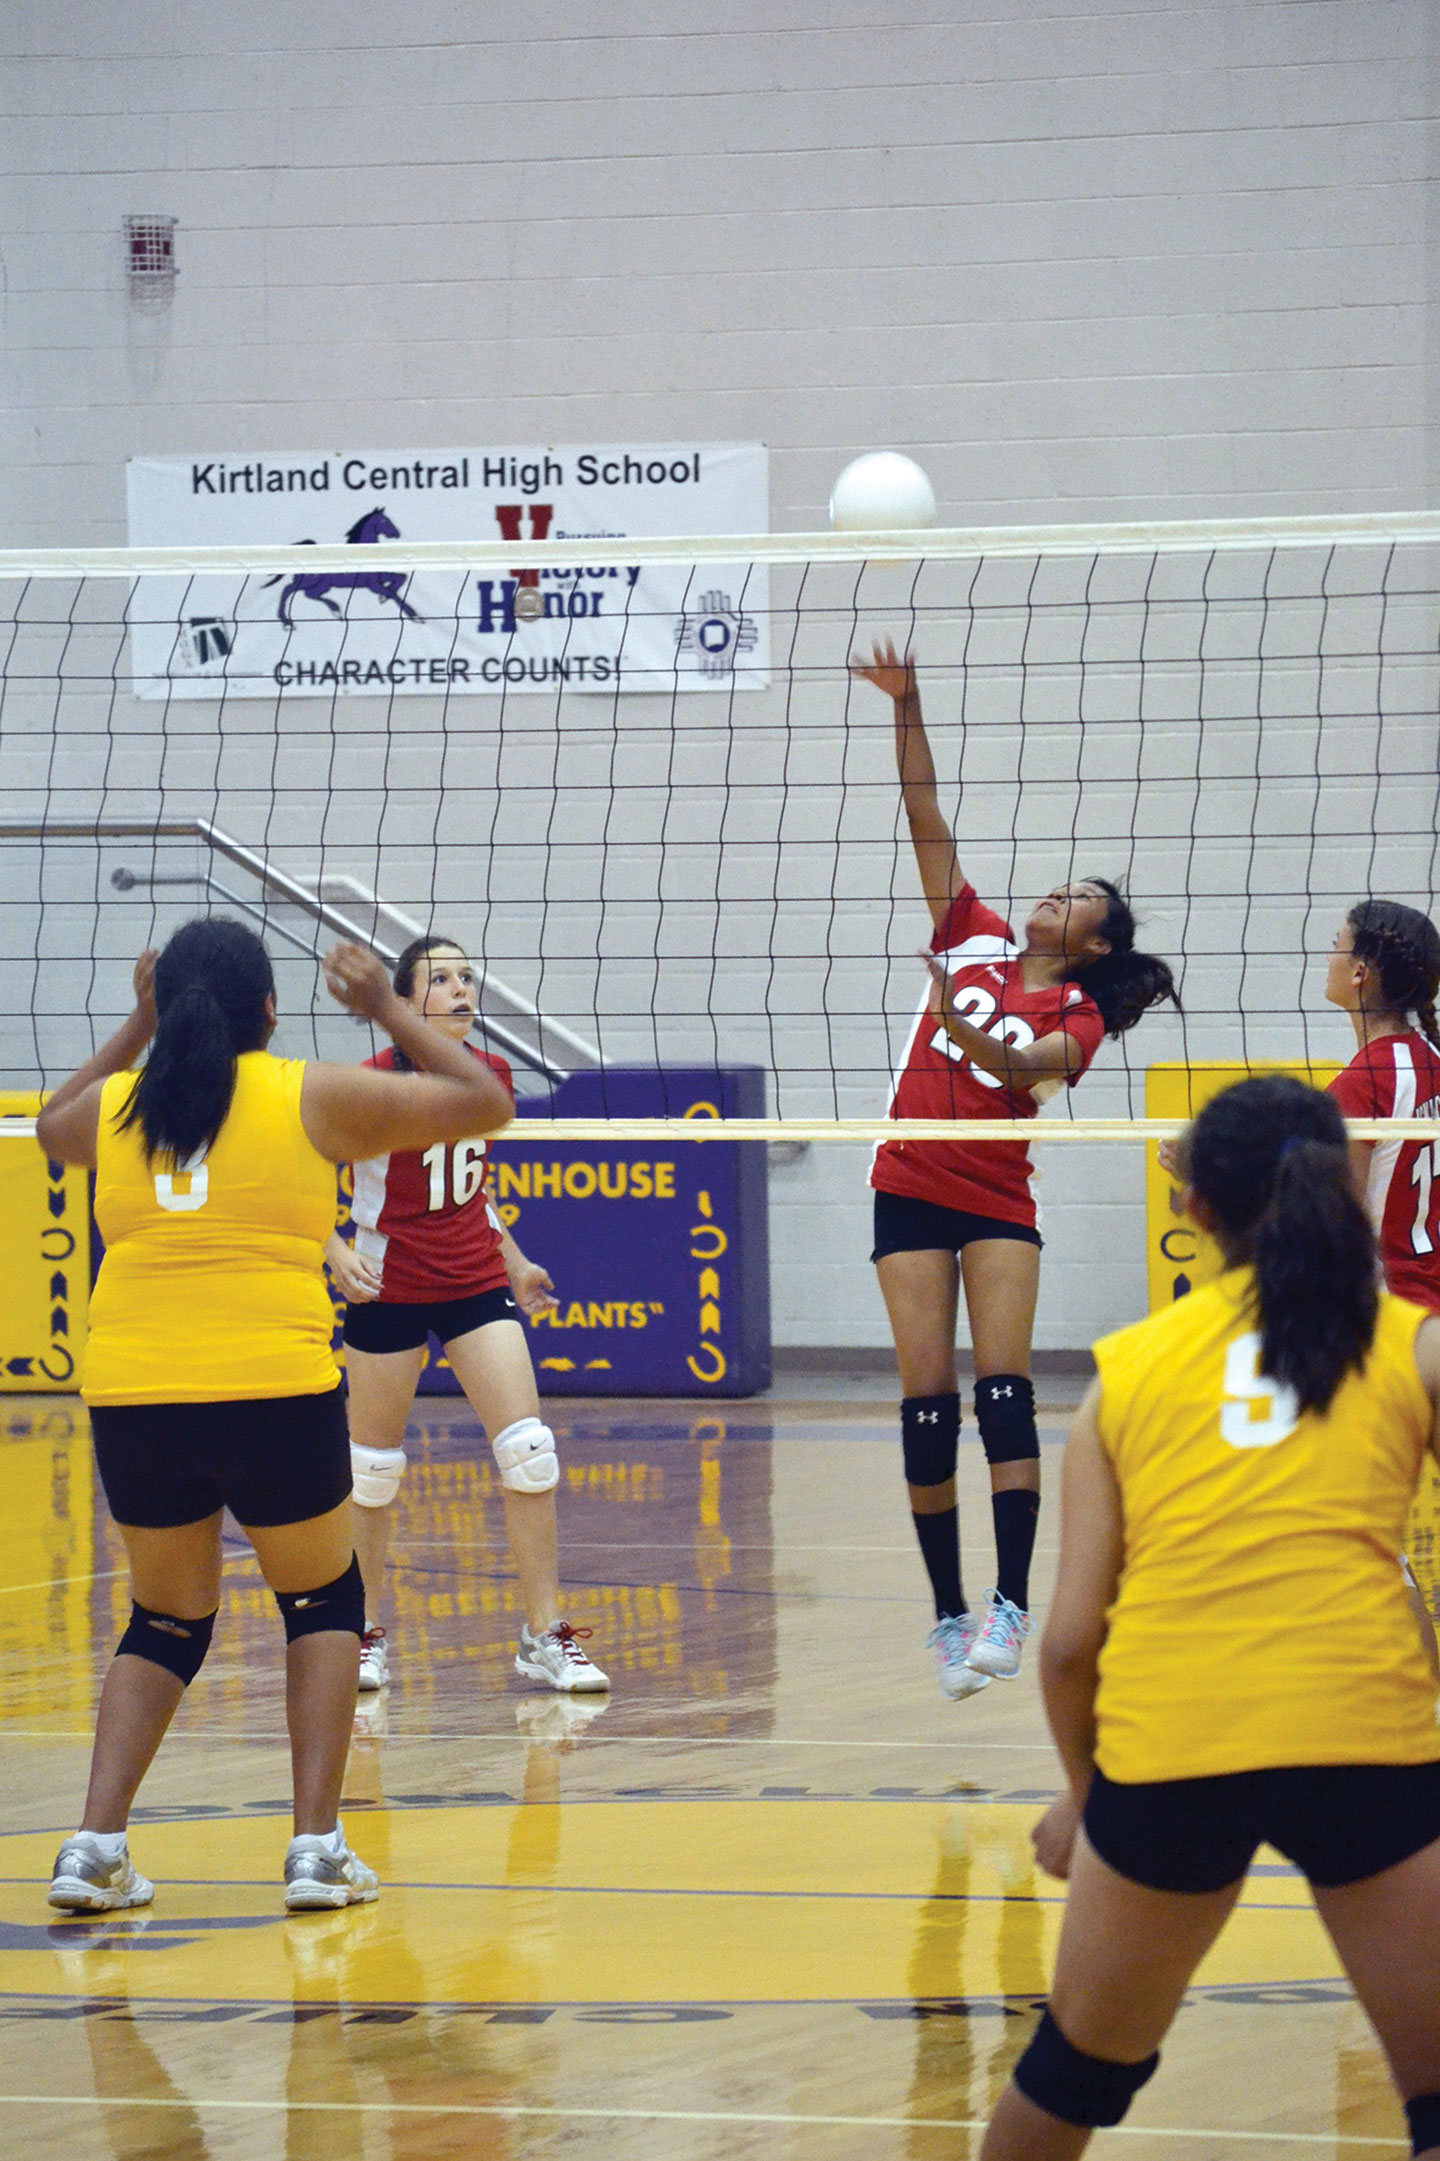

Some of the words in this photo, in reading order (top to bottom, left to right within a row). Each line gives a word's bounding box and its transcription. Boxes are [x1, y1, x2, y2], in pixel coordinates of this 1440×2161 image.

[192, 462, 330, 494] Kirtland
[343, 458, 469, 490] Central
[483, 455, 563, 495] High
[577, 453, 700, 486] School
[273, 656, 470, 688] CHARACTER
[421, 1138, 487, 1213] 16
[1410, 1140, 1440, 1257] 1
[1219, 1331, 1300, 1450] 5
